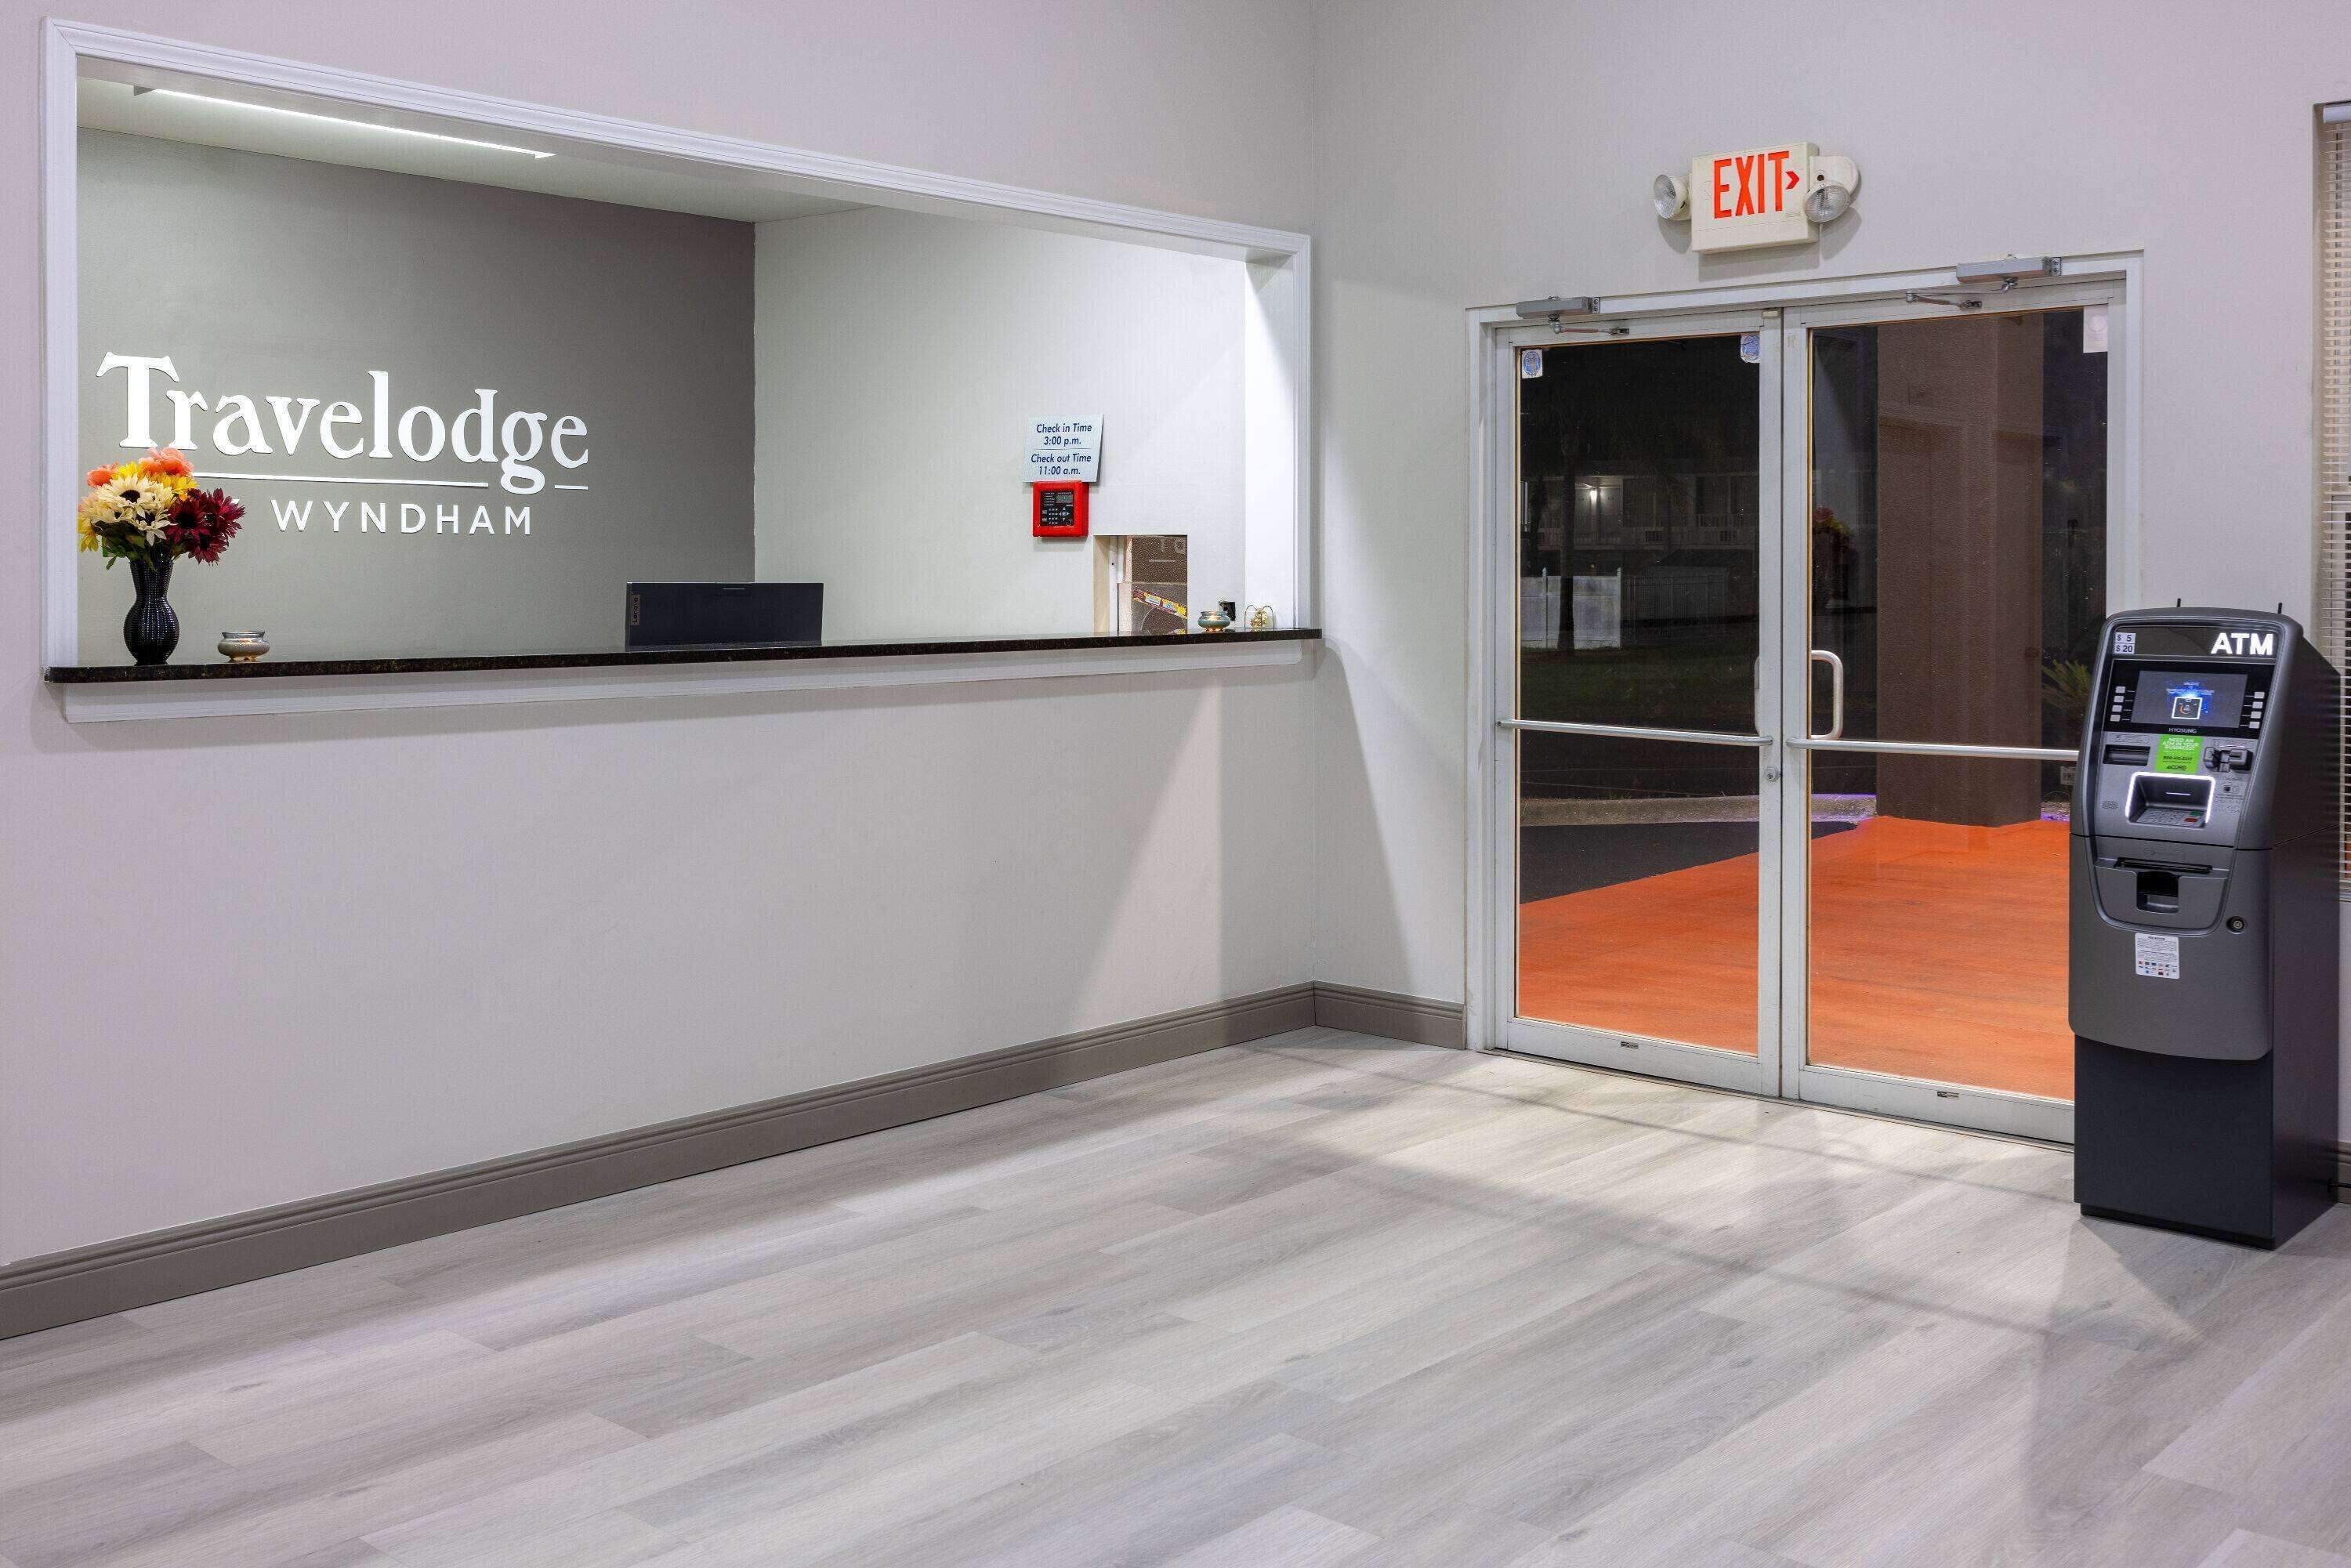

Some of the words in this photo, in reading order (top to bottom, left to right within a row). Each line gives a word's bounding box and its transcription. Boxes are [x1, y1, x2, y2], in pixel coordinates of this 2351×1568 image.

[1714, 150, 1790, 219] EXIT
[96, 351, 589, 494] Travelodge
[1036, 423, 1060, 433] Check
[1063, 423, 1070, 433] in
[1073, 423, 1092, 433] Time
[1044, 436, 1062, 445] 3:00
[1063, 437, 1081, 447] p.m.
[1031, 454, 1055, 463] Check
[1057, 454, 1070, 462] out
[1072, 453, 1092, 462] Time
[1038, 465, 1061, 475] 11:00
[270, 498, 531, 536] WYNDHAM
[2210, 632, 2273, 656] ATM
